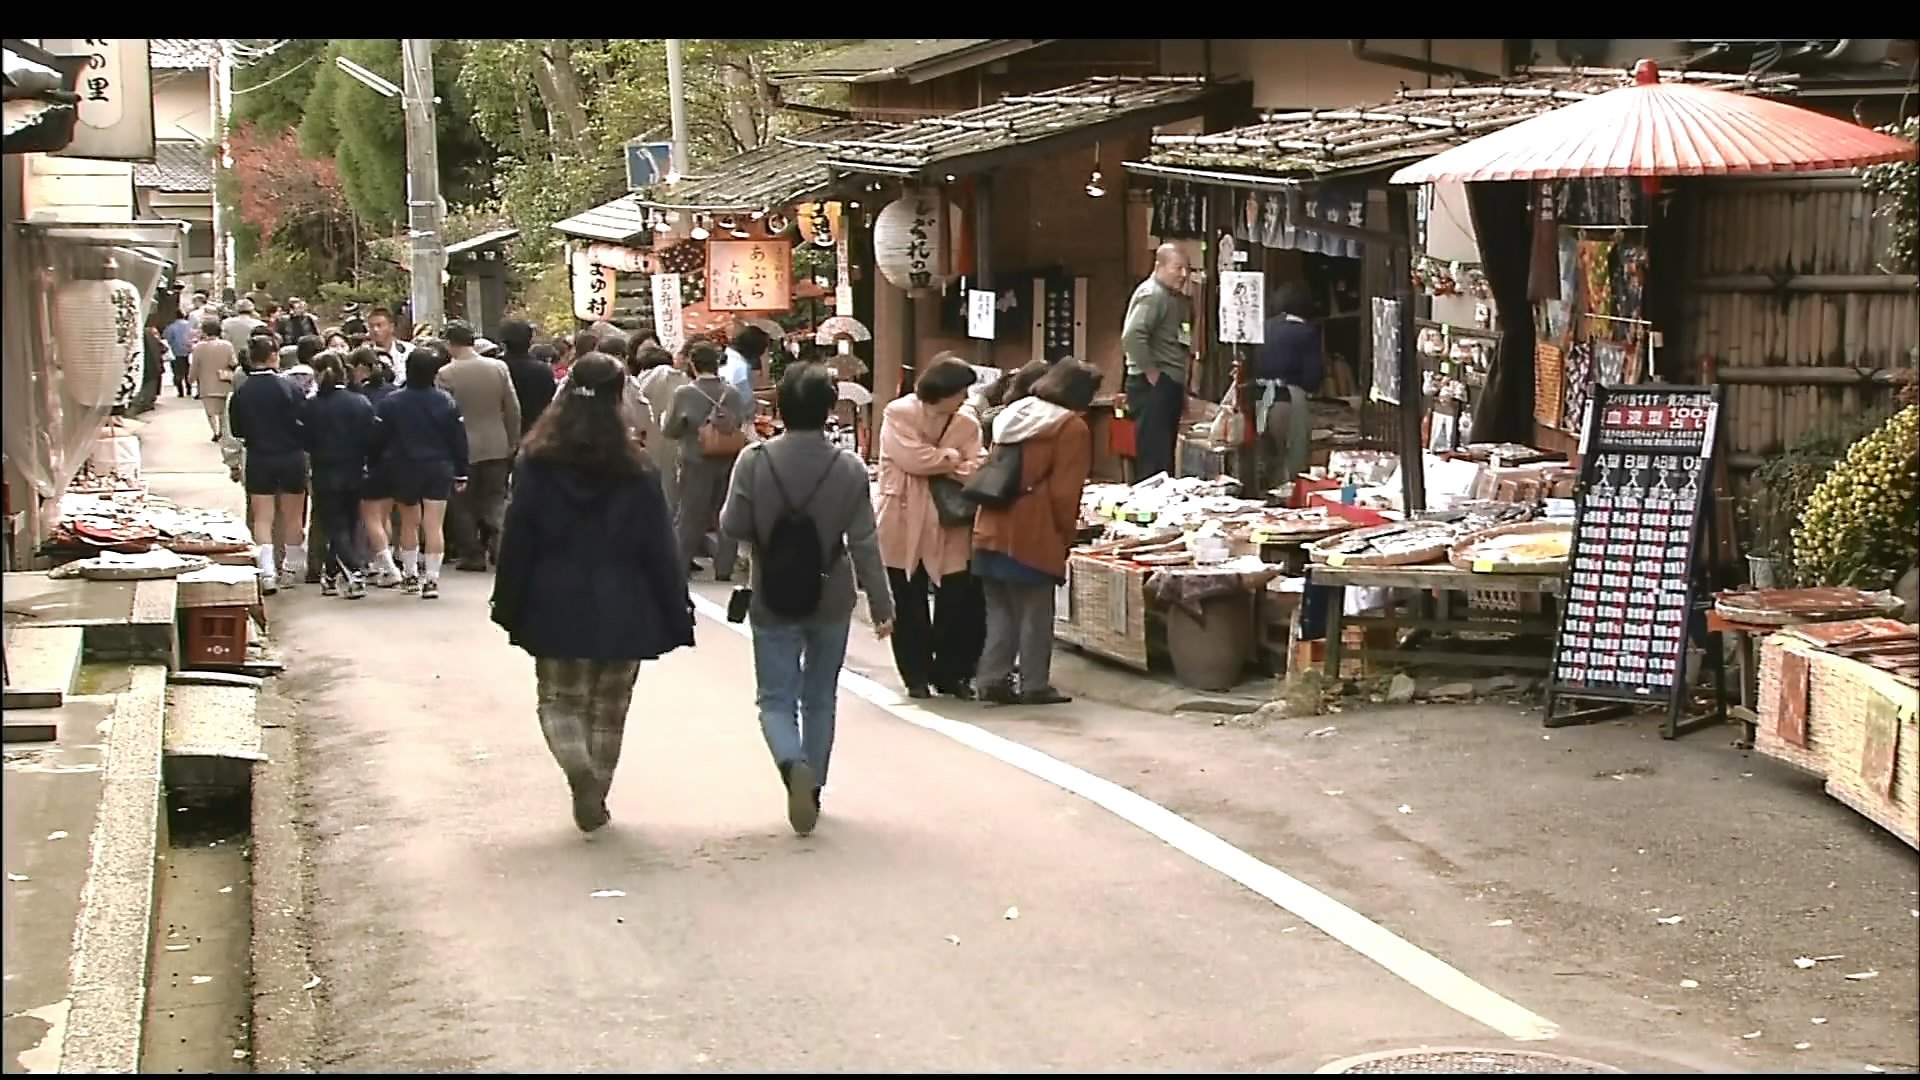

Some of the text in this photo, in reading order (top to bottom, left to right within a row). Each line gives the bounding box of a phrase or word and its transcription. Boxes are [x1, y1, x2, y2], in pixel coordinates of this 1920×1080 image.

[586, 262, 608, 317] まゆ村
[726, 260, 748, 308] とり紙
[749, 244, 766, 300] あぶら
